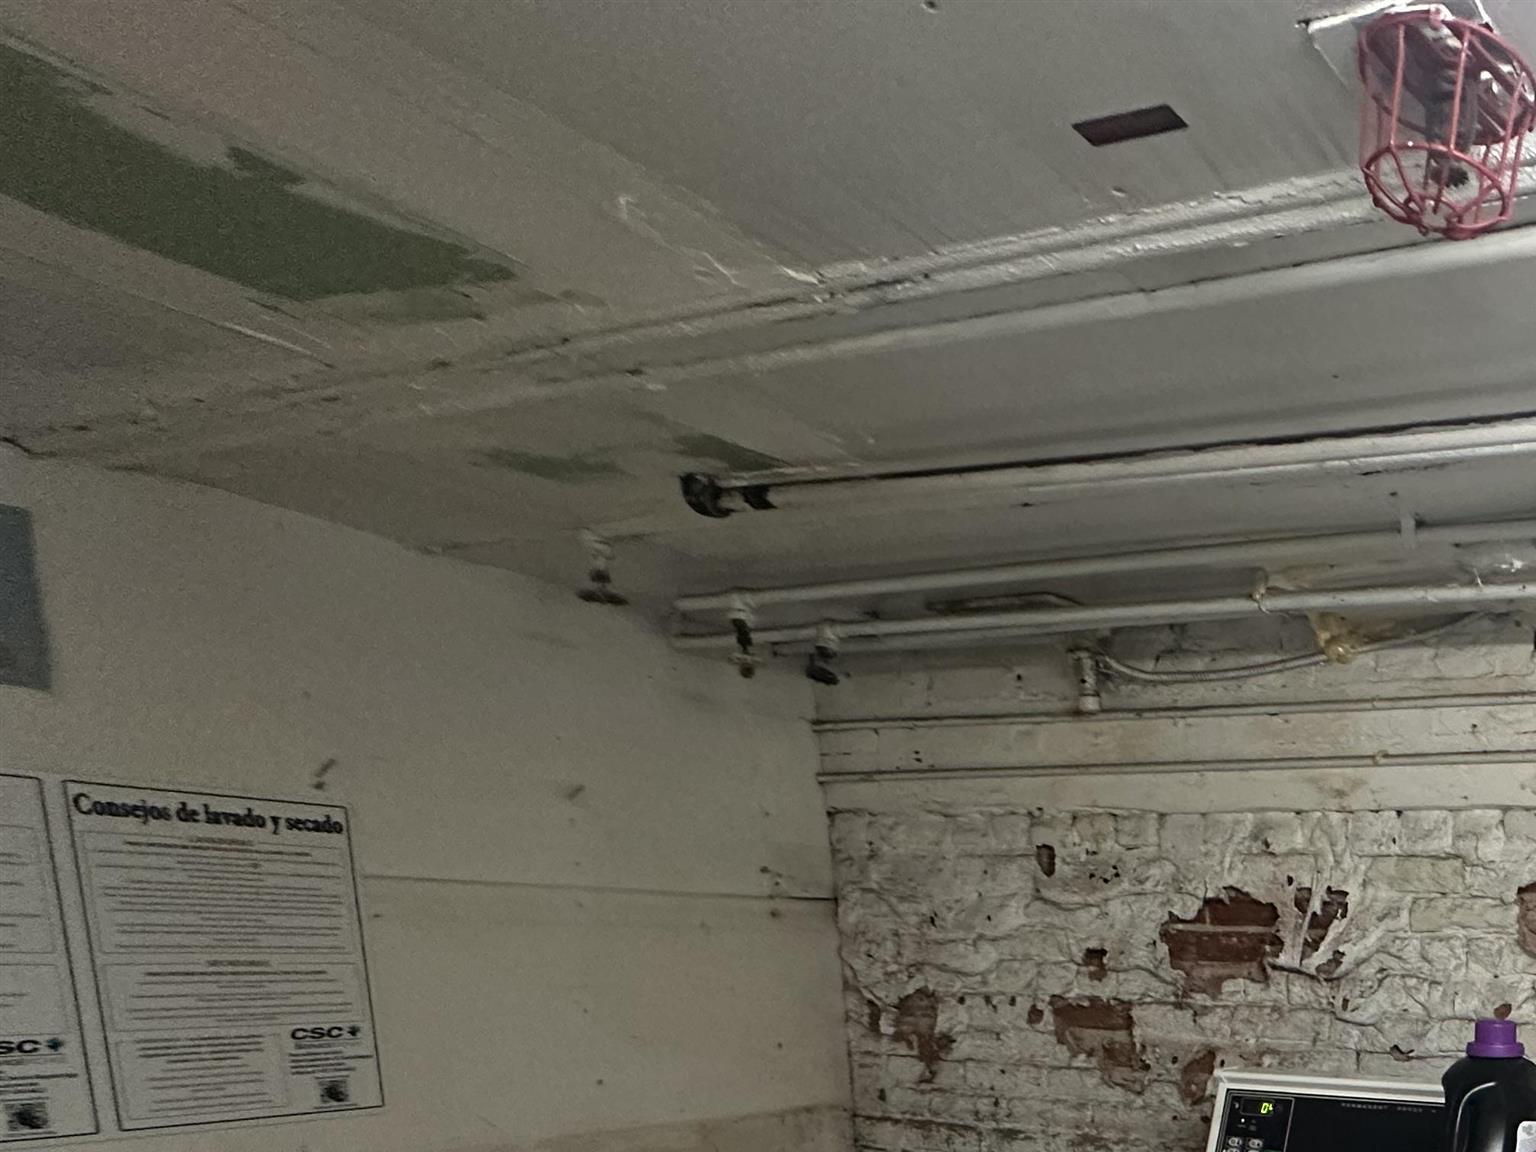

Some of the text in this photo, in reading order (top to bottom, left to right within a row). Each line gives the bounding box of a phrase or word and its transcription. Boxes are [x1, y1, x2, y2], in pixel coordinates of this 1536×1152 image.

[73, 792, 171, 825] Consejos
[176, 801, 201, 822] de
[269, 815, 282, 835] y
[285, 815, 344, 834] secado
[291, 1026, 344, 1040] CSC
[0, 1040, 42, 1055] SC
